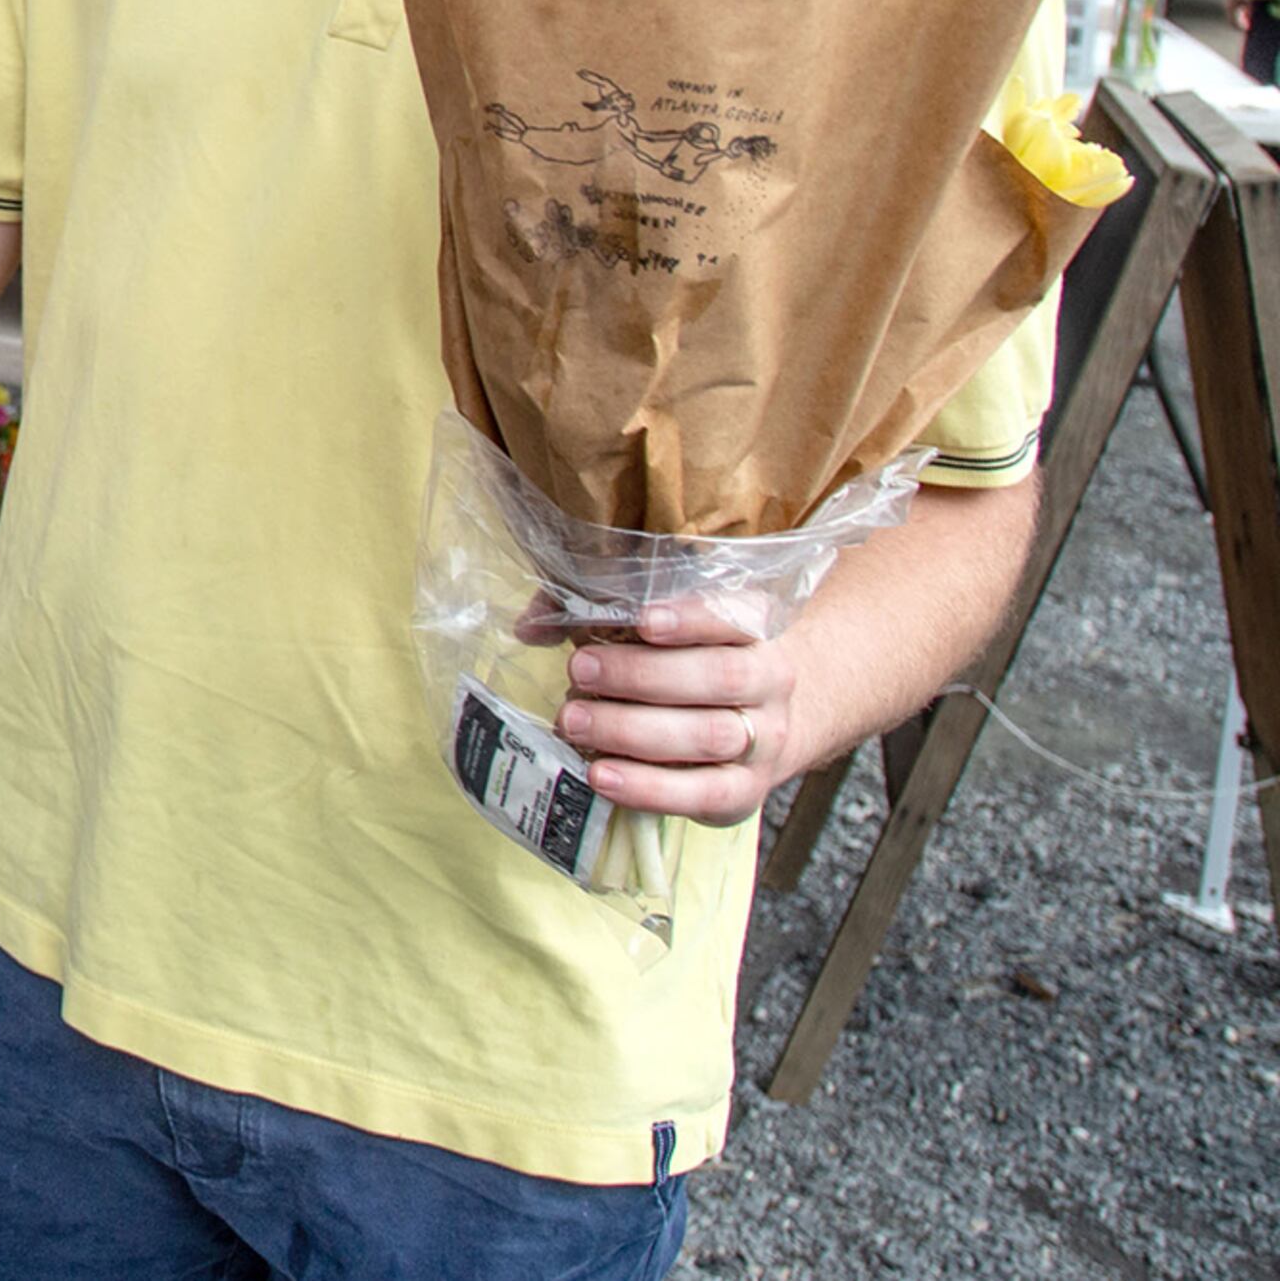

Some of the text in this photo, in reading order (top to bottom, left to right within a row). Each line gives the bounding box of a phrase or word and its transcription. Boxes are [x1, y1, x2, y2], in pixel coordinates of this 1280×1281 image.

[667, 78, 743, 98] GROWN IN
[724, 105, 785, 125] GEORGIA
